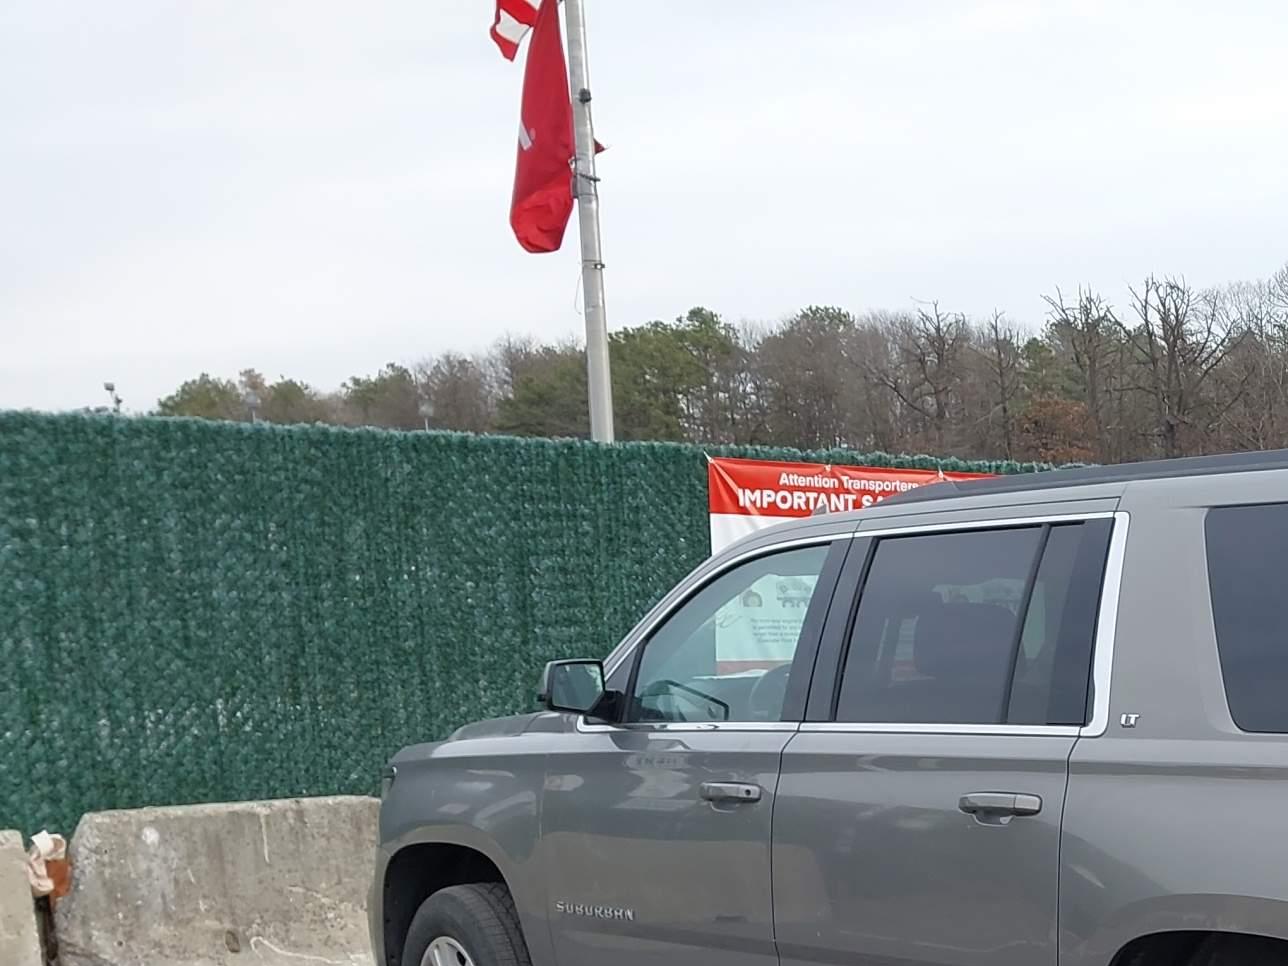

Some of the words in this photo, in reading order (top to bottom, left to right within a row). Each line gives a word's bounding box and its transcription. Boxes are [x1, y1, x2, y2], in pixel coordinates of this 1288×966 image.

[779, 472, 839, 489] Attention
[737, 487, 858, 513] IMPORTANT
[1120, 713, 1140, 728] LT
[556, 900, 634, 921] SUBURBAN
